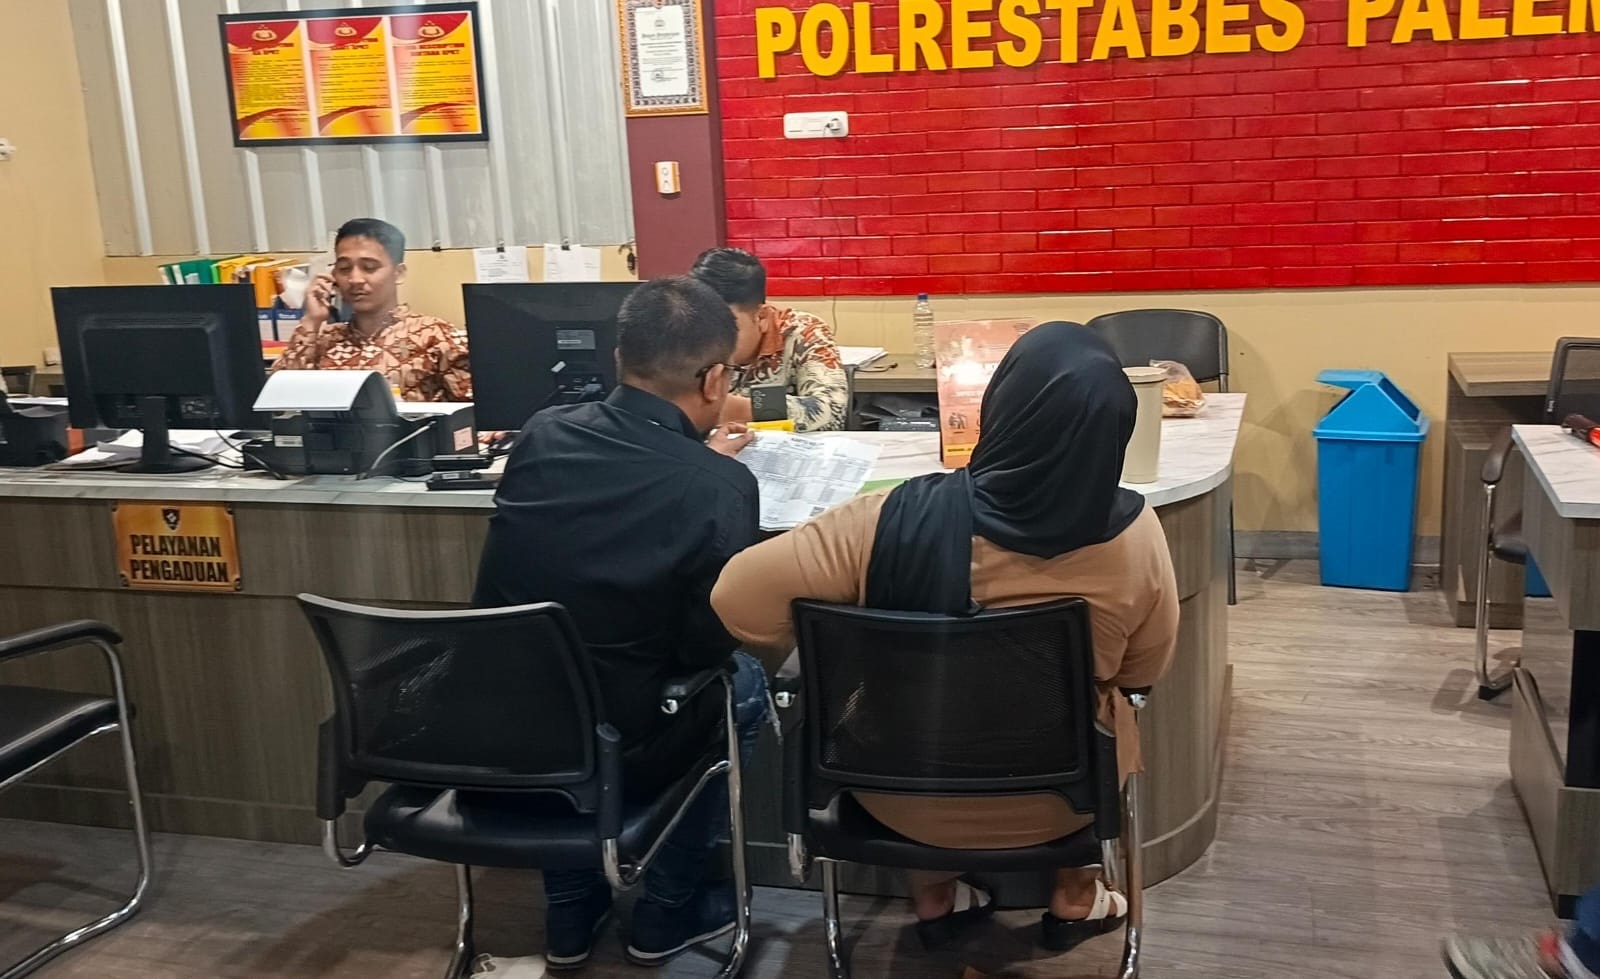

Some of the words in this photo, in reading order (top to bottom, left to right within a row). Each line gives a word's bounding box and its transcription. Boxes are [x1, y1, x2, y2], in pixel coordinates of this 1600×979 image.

[755, 0, 1304, 79] POLRESTABES
[1348, 0, 1600, 47] PALE
[130, 534, 222, 557] PELAYANAN
[130, 559, 230, 582] PENGADUAN
